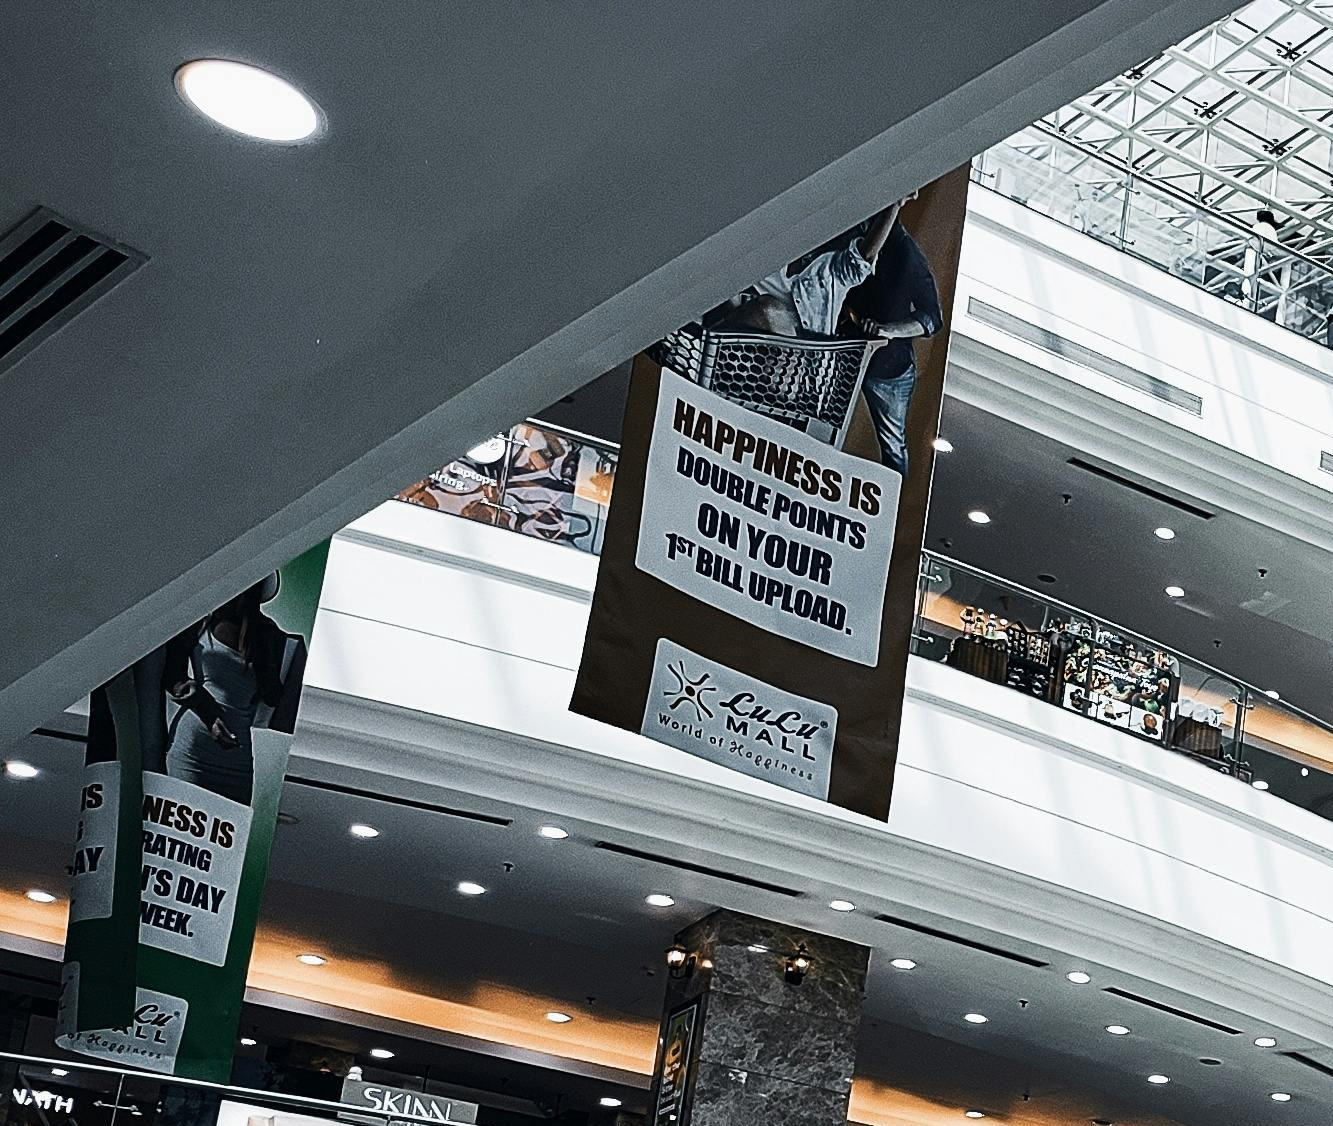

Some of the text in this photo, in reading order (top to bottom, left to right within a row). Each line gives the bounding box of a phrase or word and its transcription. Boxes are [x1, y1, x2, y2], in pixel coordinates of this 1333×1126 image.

[449, 464, 498, 488] Laptops
[673, 398, 881, 516] HAPPINESS IS
[677, 445, 866, 550] DOUBLE POINTS
[697, 503, 833, 585] ON YOUR
[665, 533, 851, 635] 1ST BILL UPLOAD.
[719, 693, 820, 739] LuLu
[726, 714, 816, 762] MALL
[658, 713, 813, 781] World of Happiness
[210, 817, 235, 849] IS
[176, 876, 226, 914] DAY
[86, 1034, 162, 1059] Happiness
